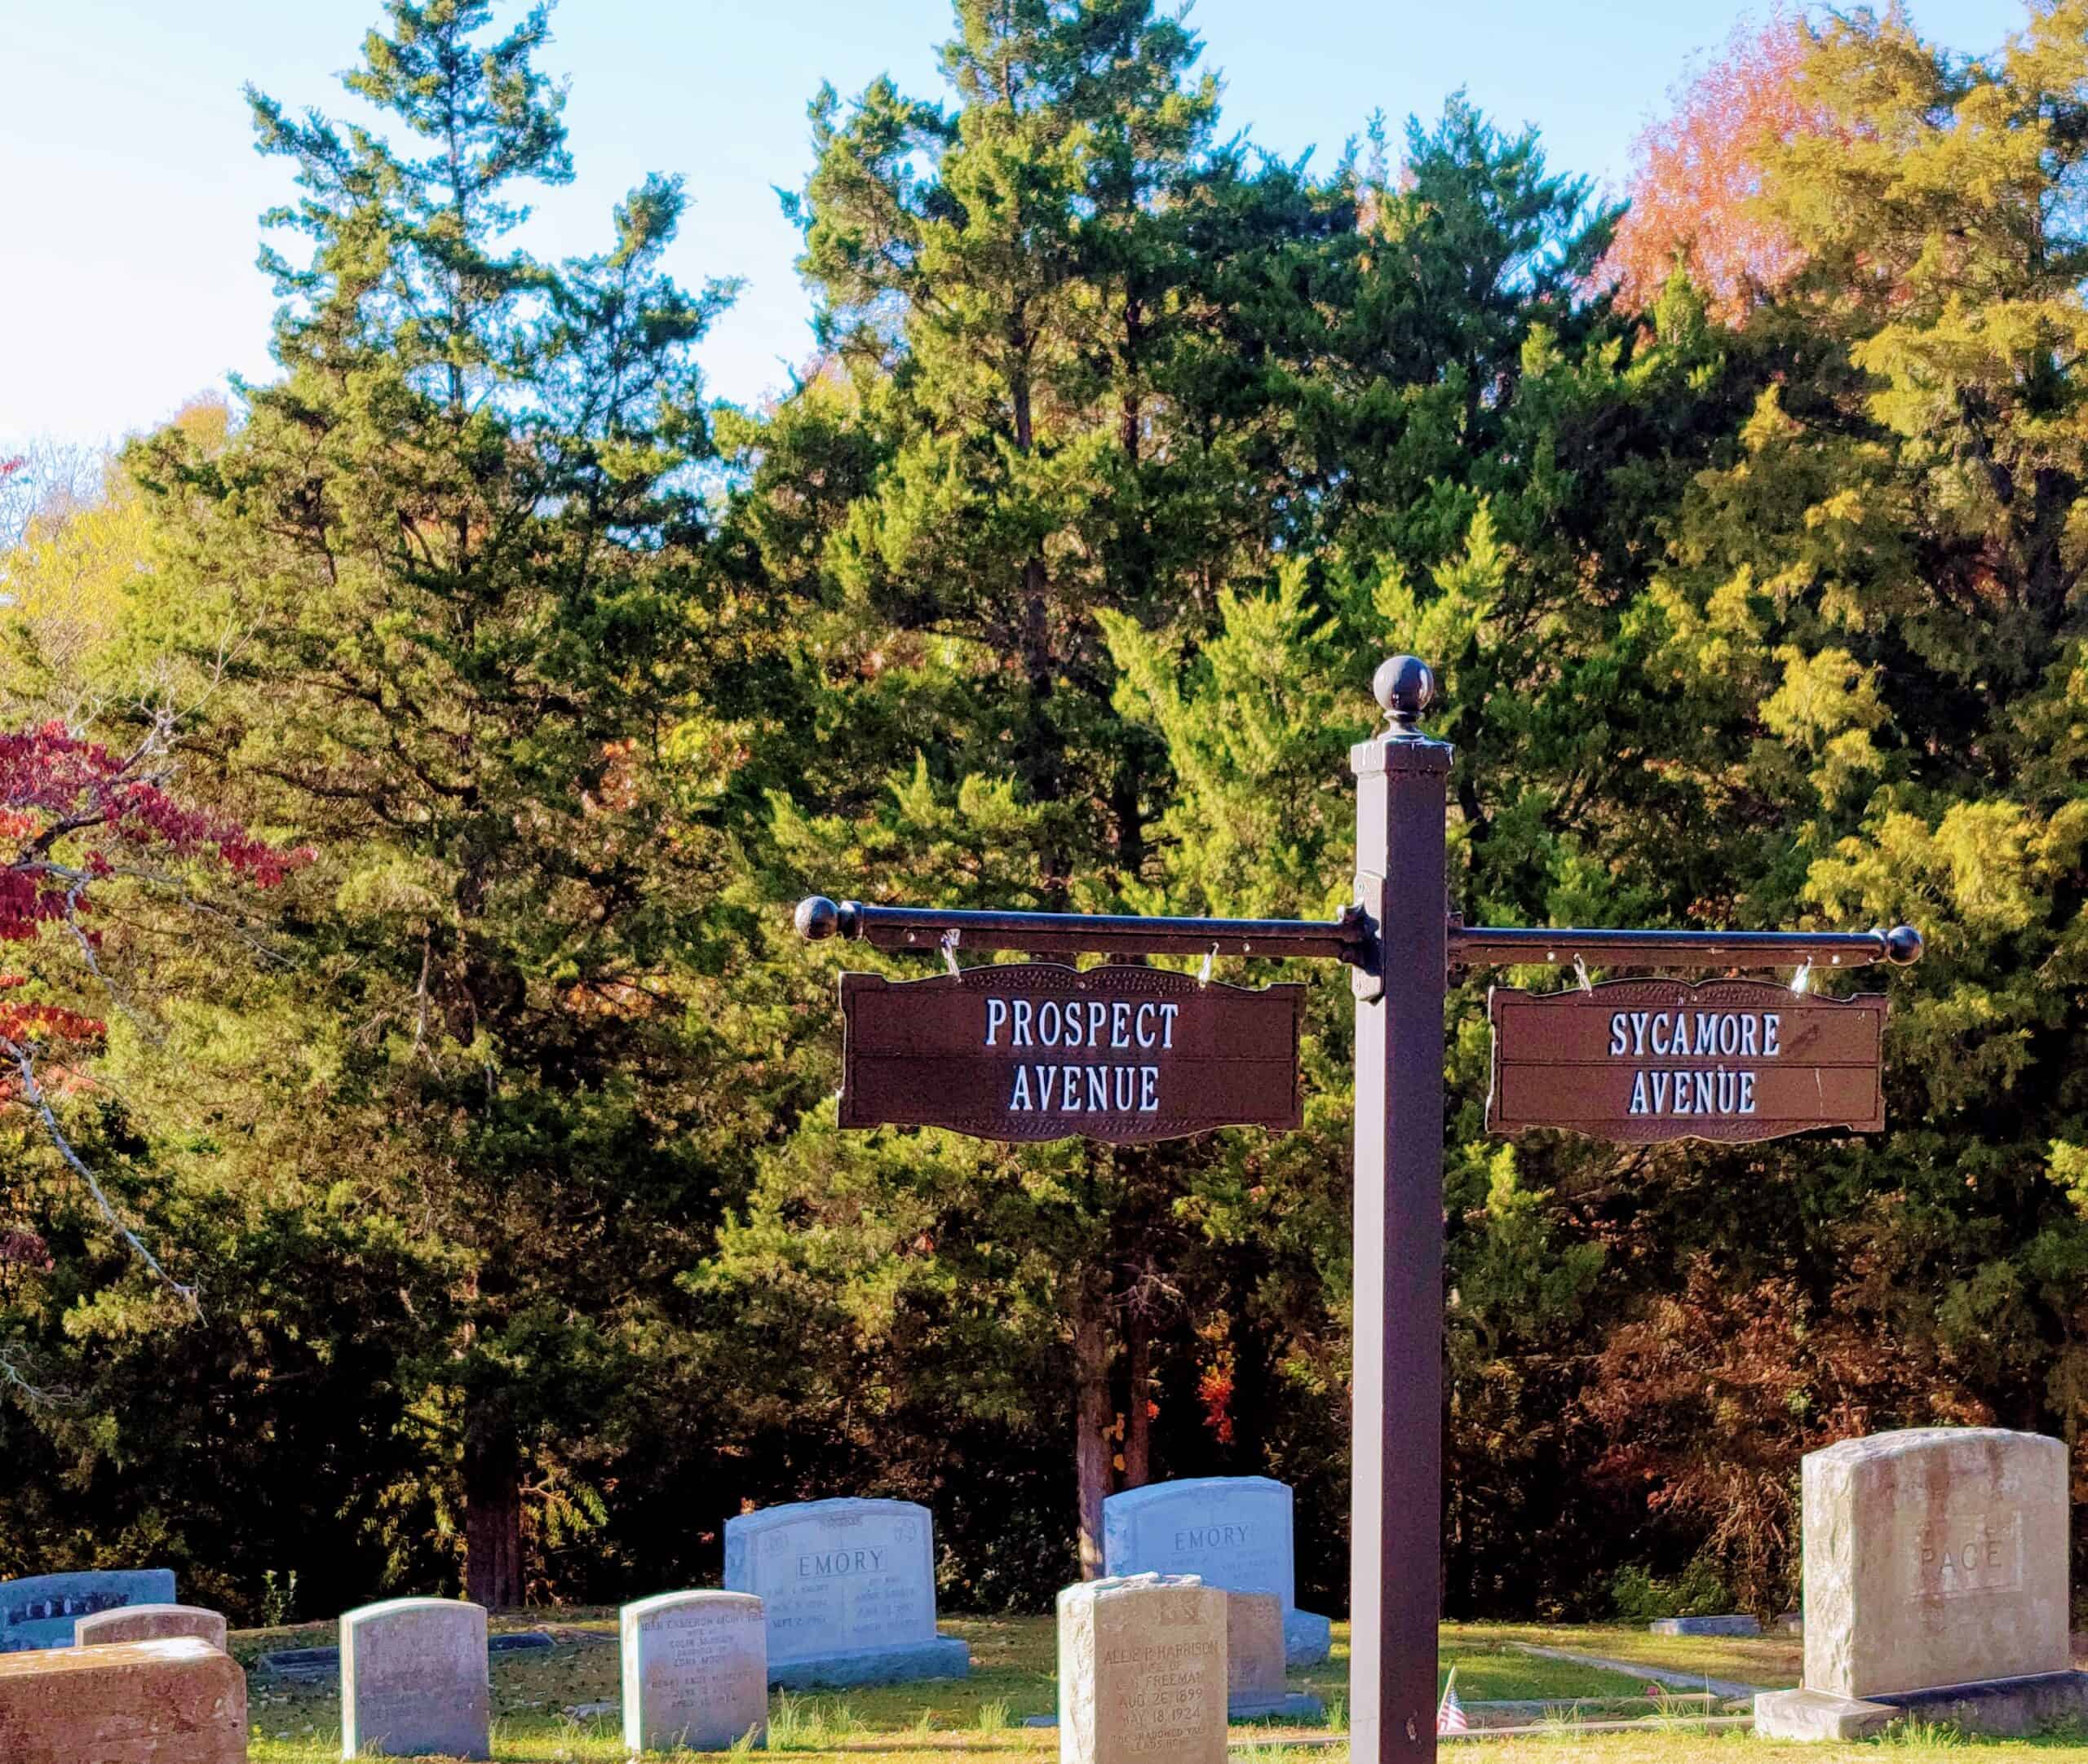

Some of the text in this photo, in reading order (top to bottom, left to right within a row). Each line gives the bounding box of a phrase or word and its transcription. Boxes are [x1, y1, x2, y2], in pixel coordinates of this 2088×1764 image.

[984, 998, 1179, 1050] PROSPECT
[1609, 1011, 1781, 1057] SYCAMORE
[1009, 1063, 1160, 1112] AVENUE
[1629, 1069, 1756, 1115] AVENUE
[1174, 1524, 1249, 1550] EMORY
[798, 1549, 883, 1577] EMORY
